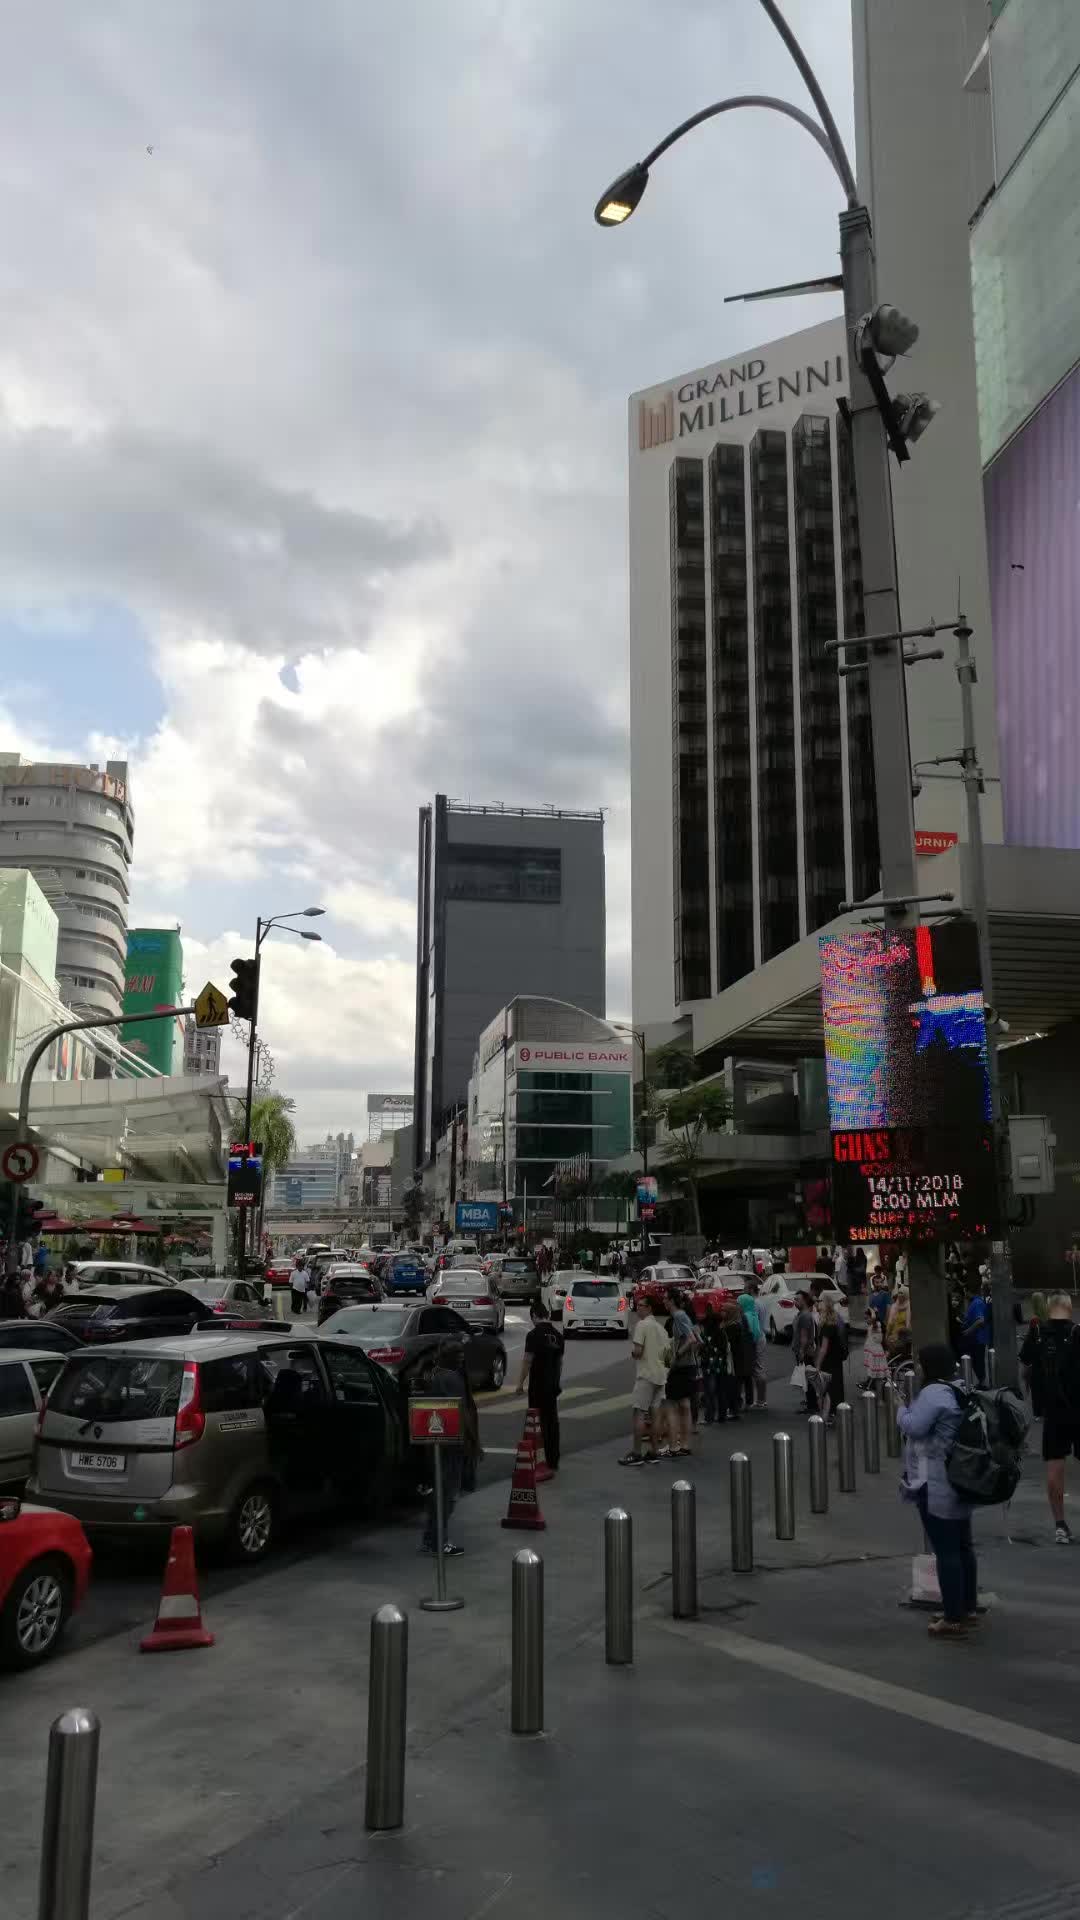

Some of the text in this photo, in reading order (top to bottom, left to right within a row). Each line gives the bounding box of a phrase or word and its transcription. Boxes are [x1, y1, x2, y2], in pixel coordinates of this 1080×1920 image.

[678, 359, 765, 402] GRAND
[535, 1051, 628, 1061] PUBLIC BANK
[868, 1175, 964, 1193] 14/11/2018
[872, 1192, 960, 1210] 8:00 MLM
[462, 1208, 490, 1220] MBA
[96, 1456, 118, 1468] 5706
